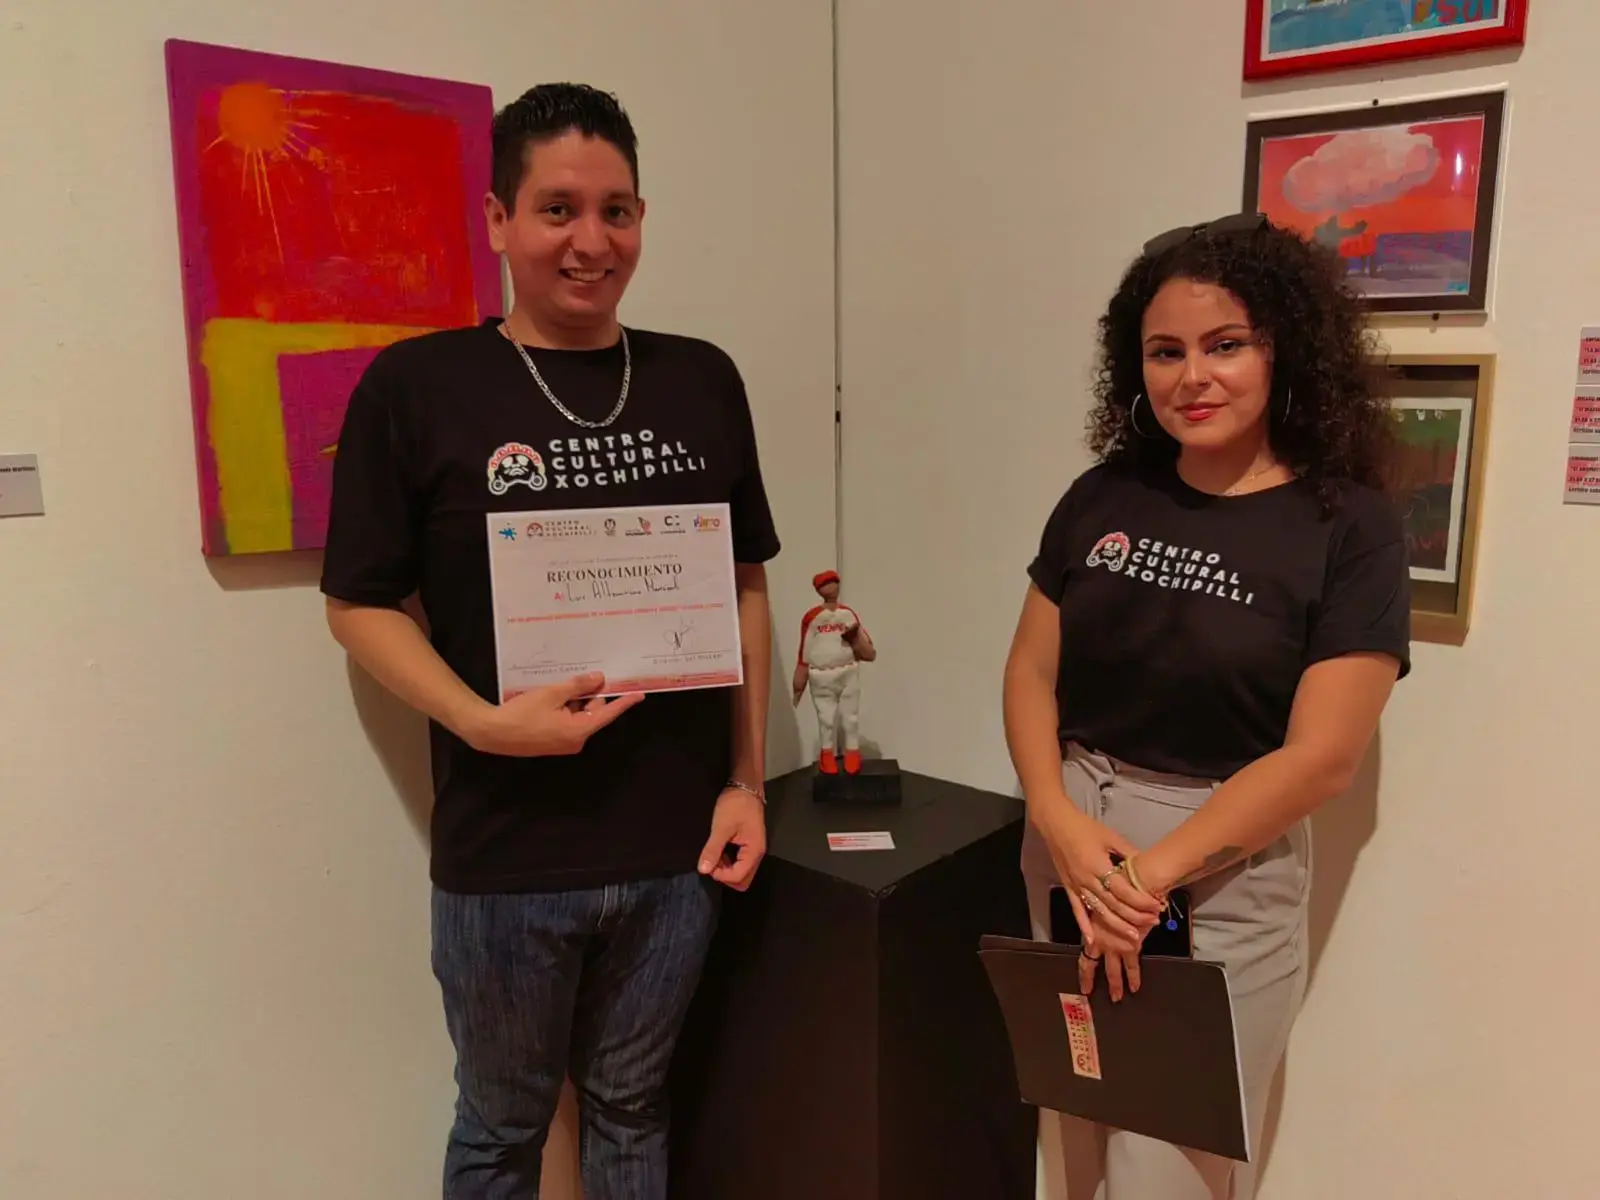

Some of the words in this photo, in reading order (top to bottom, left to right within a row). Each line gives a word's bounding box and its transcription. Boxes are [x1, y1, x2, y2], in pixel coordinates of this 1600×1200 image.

[549, 430, 653, 452] CENTRO
[552, 441, 687, 470] CULTURAL
[554, 457, 705, 488] XOCHIPILLI
[1138, 538, 1221, 564] CENTRO
[546, 562, 683, 583] RECONOCIMIENTO
[1132, 551, 1241, 585] CULTURAL
[1124, 564, 1254, 605] XOCHIPILLI
